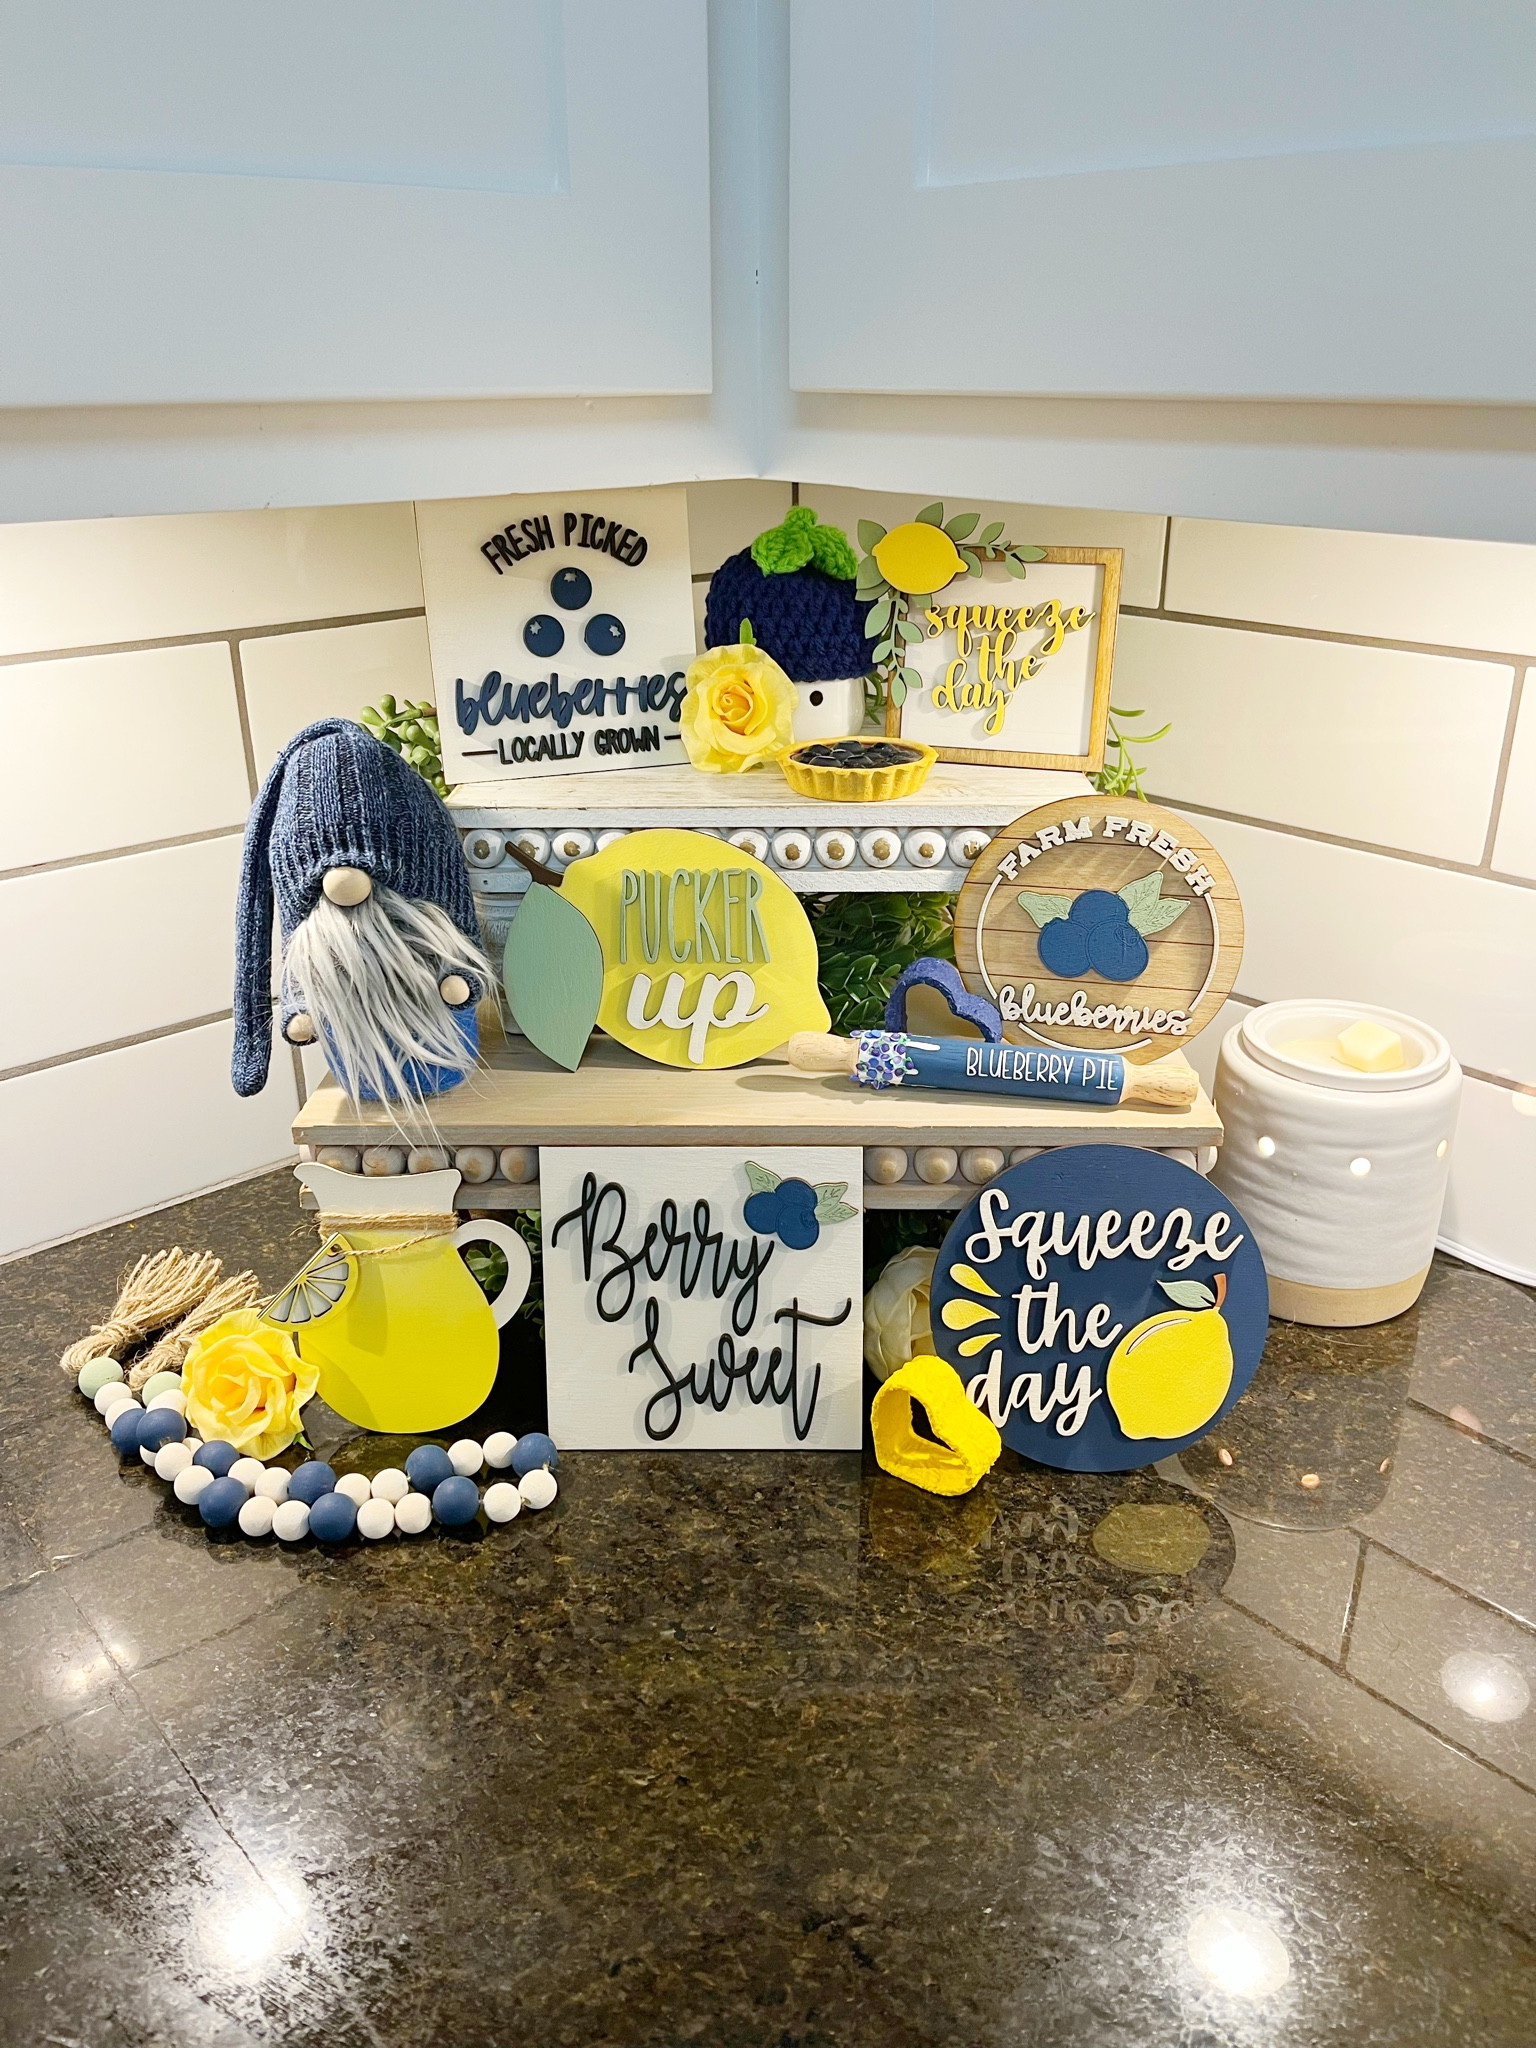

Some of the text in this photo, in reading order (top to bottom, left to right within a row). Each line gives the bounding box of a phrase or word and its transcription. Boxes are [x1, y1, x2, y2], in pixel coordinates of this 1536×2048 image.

[481, 512, 648, 575] FRESH PICKED
[924, 599, 1096, 657] squeeze
[977, 628, 1047, 691] the
[455, 670, 687, 736] blueberries
[931, 658, 1014, 735] day
[499, 725, 660, 765] LOCALLY GROWN
[997, 815, 1216, 896] FARM FRESH
[619, 867, 771, 963] PUCKER
[626, 970, 770, 1064] up
[998, 982, 1193, 1036] blueberries
[966, 1047, 1118, 1091] BLUEBERRY PIE
[551, 1171, 775, 1336] Berry
[965, 1188, 1244, 1280] Squeeze
[1011, 1281, 1123, 1355] the
[628, 1296, 852, 1441] Sweet
[965, 1349, 1103, 1437] day
